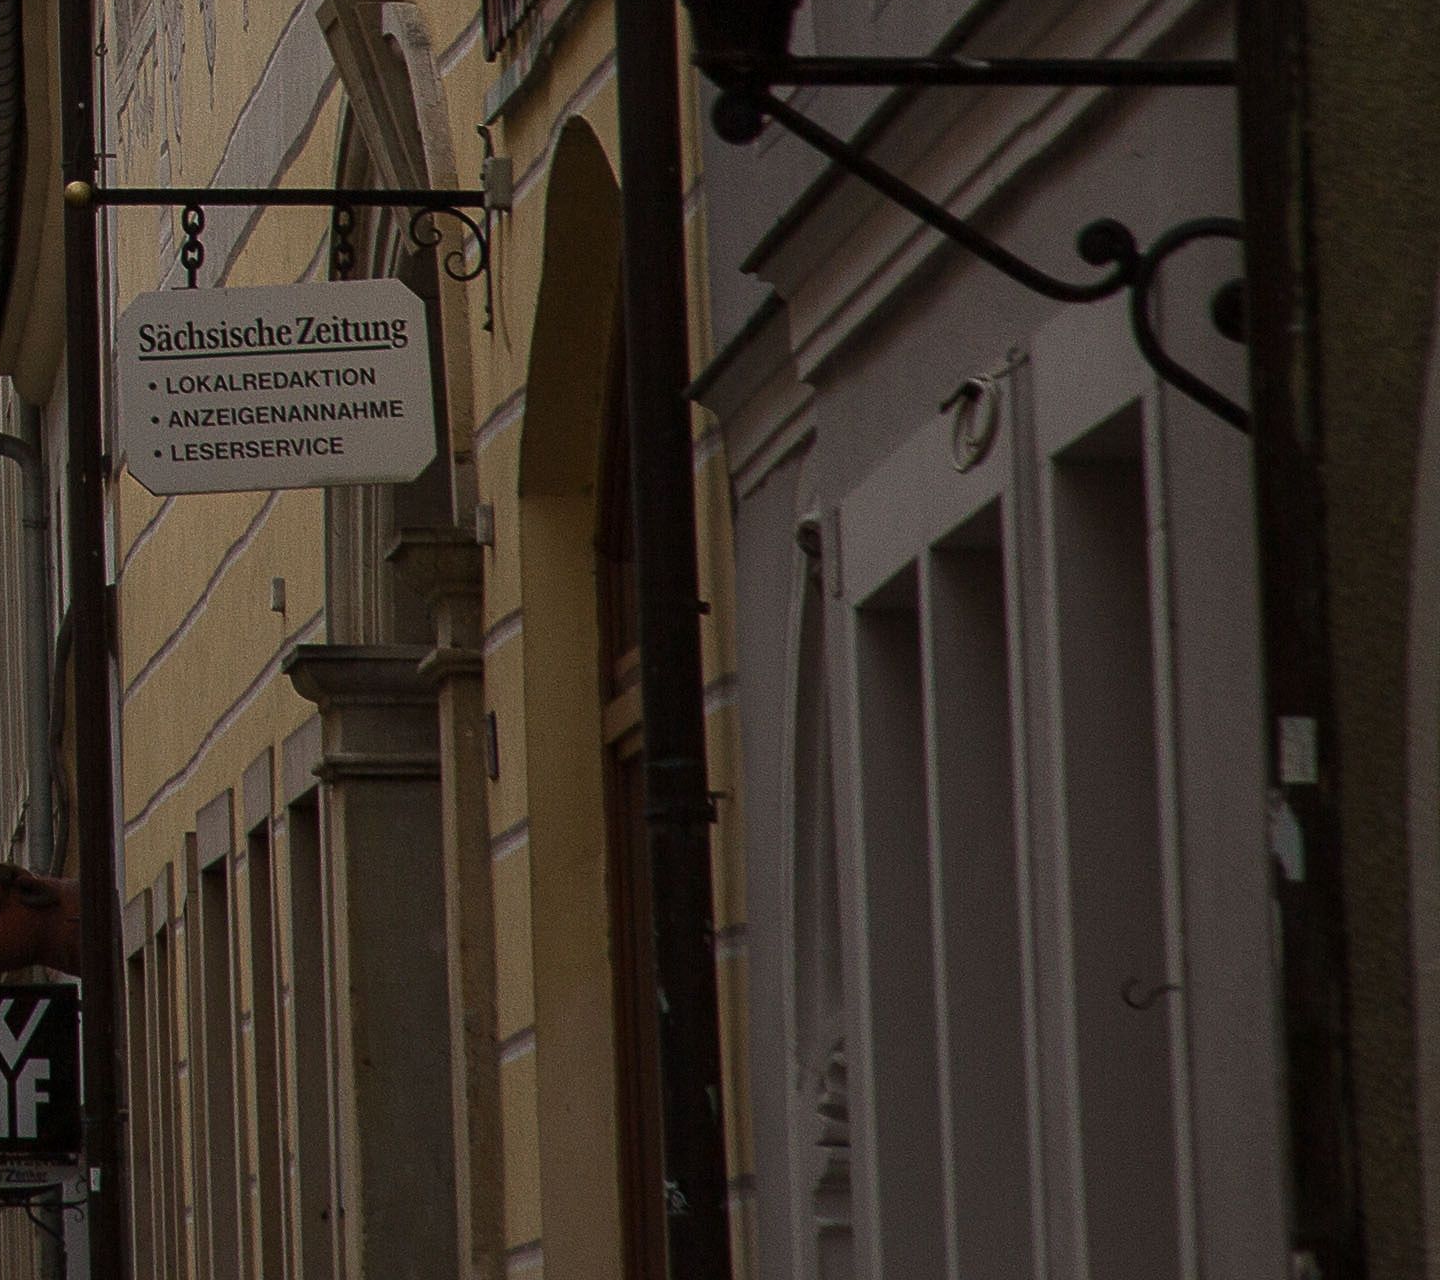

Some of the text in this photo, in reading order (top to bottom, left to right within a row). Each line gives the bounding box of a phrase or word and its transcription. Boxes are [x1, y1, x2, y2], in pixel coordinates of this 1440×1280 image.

[139, 314, 408, 352] Sächsische Zeitung
[166, 367, 376, 395] LOKALREDAKTION
[168, 399, 404, 428] ANZEIGENANNAHME
[171, 436, 344, 462] LESERSERVICE
